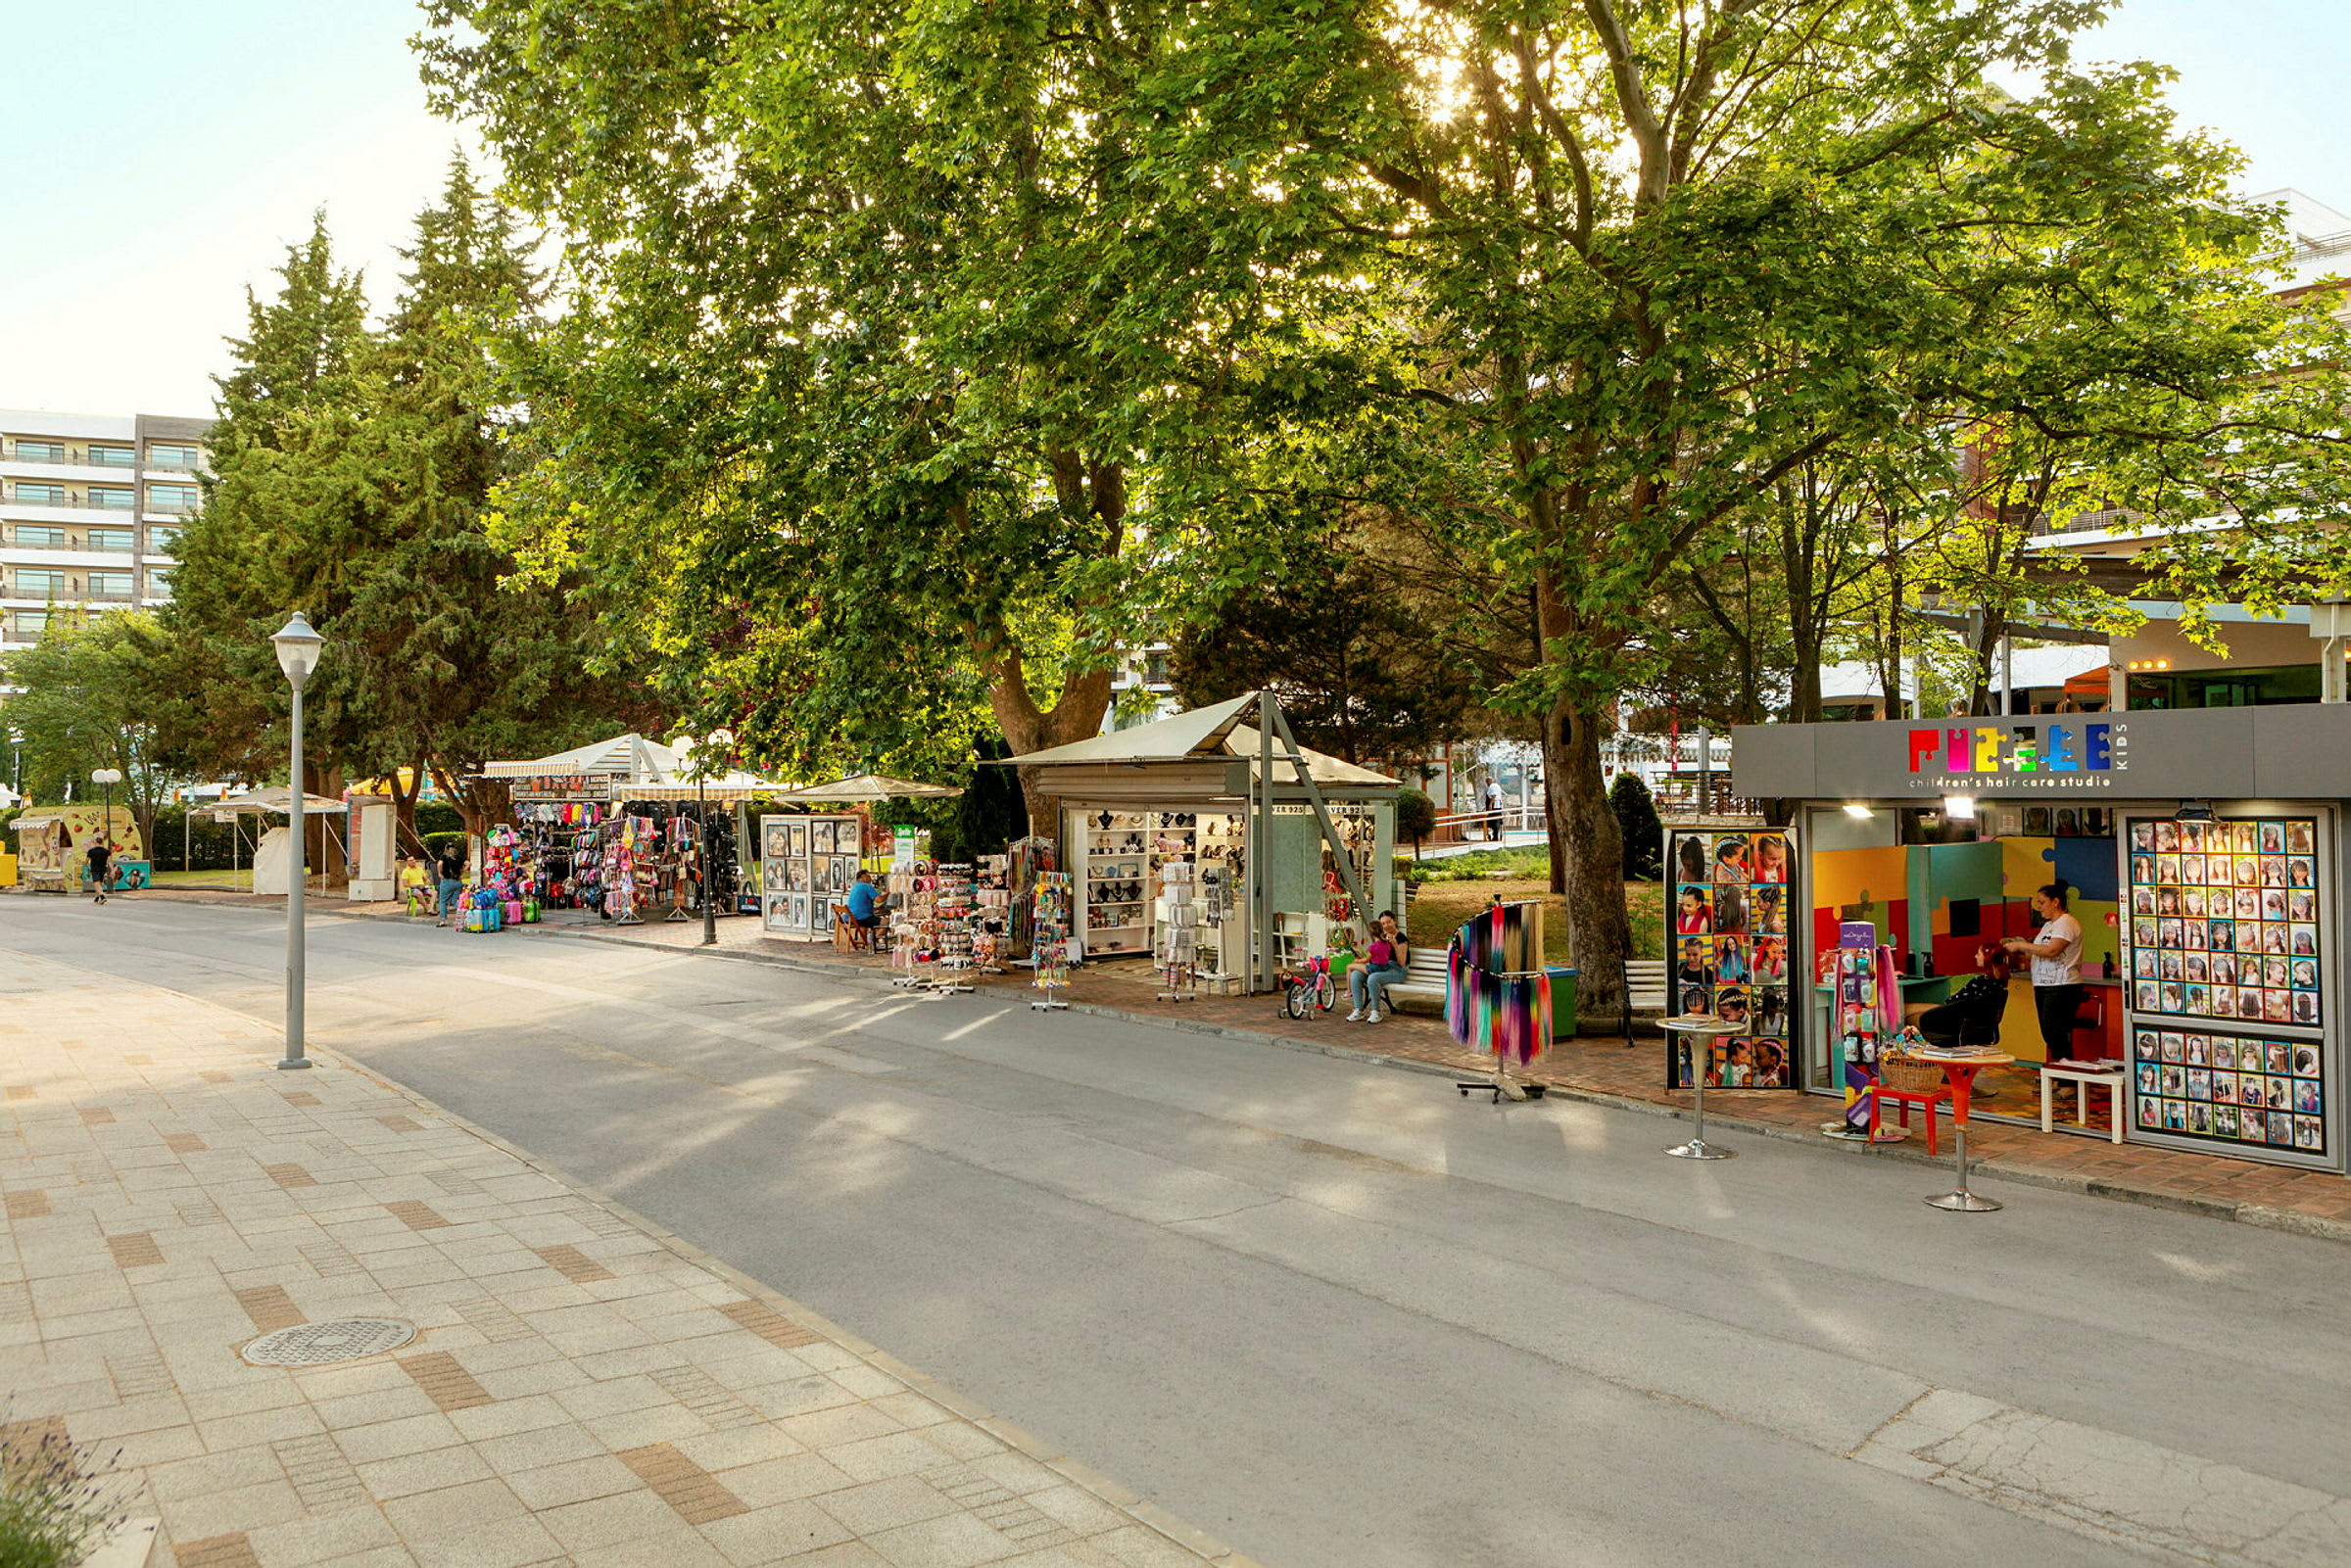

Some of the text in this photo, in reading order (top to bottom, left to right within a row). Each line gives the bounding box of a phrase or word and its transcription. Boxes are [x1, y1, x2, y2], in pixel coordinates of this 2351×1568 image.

[1908, 724, 2111, 772] PUZZLE
[2116, 723, 2128, 770] KIDS
[1987, 777, 2017, 787] hair
[2022, 779, 2055, 787] care
[2060, 776, 2111, 787] studio
